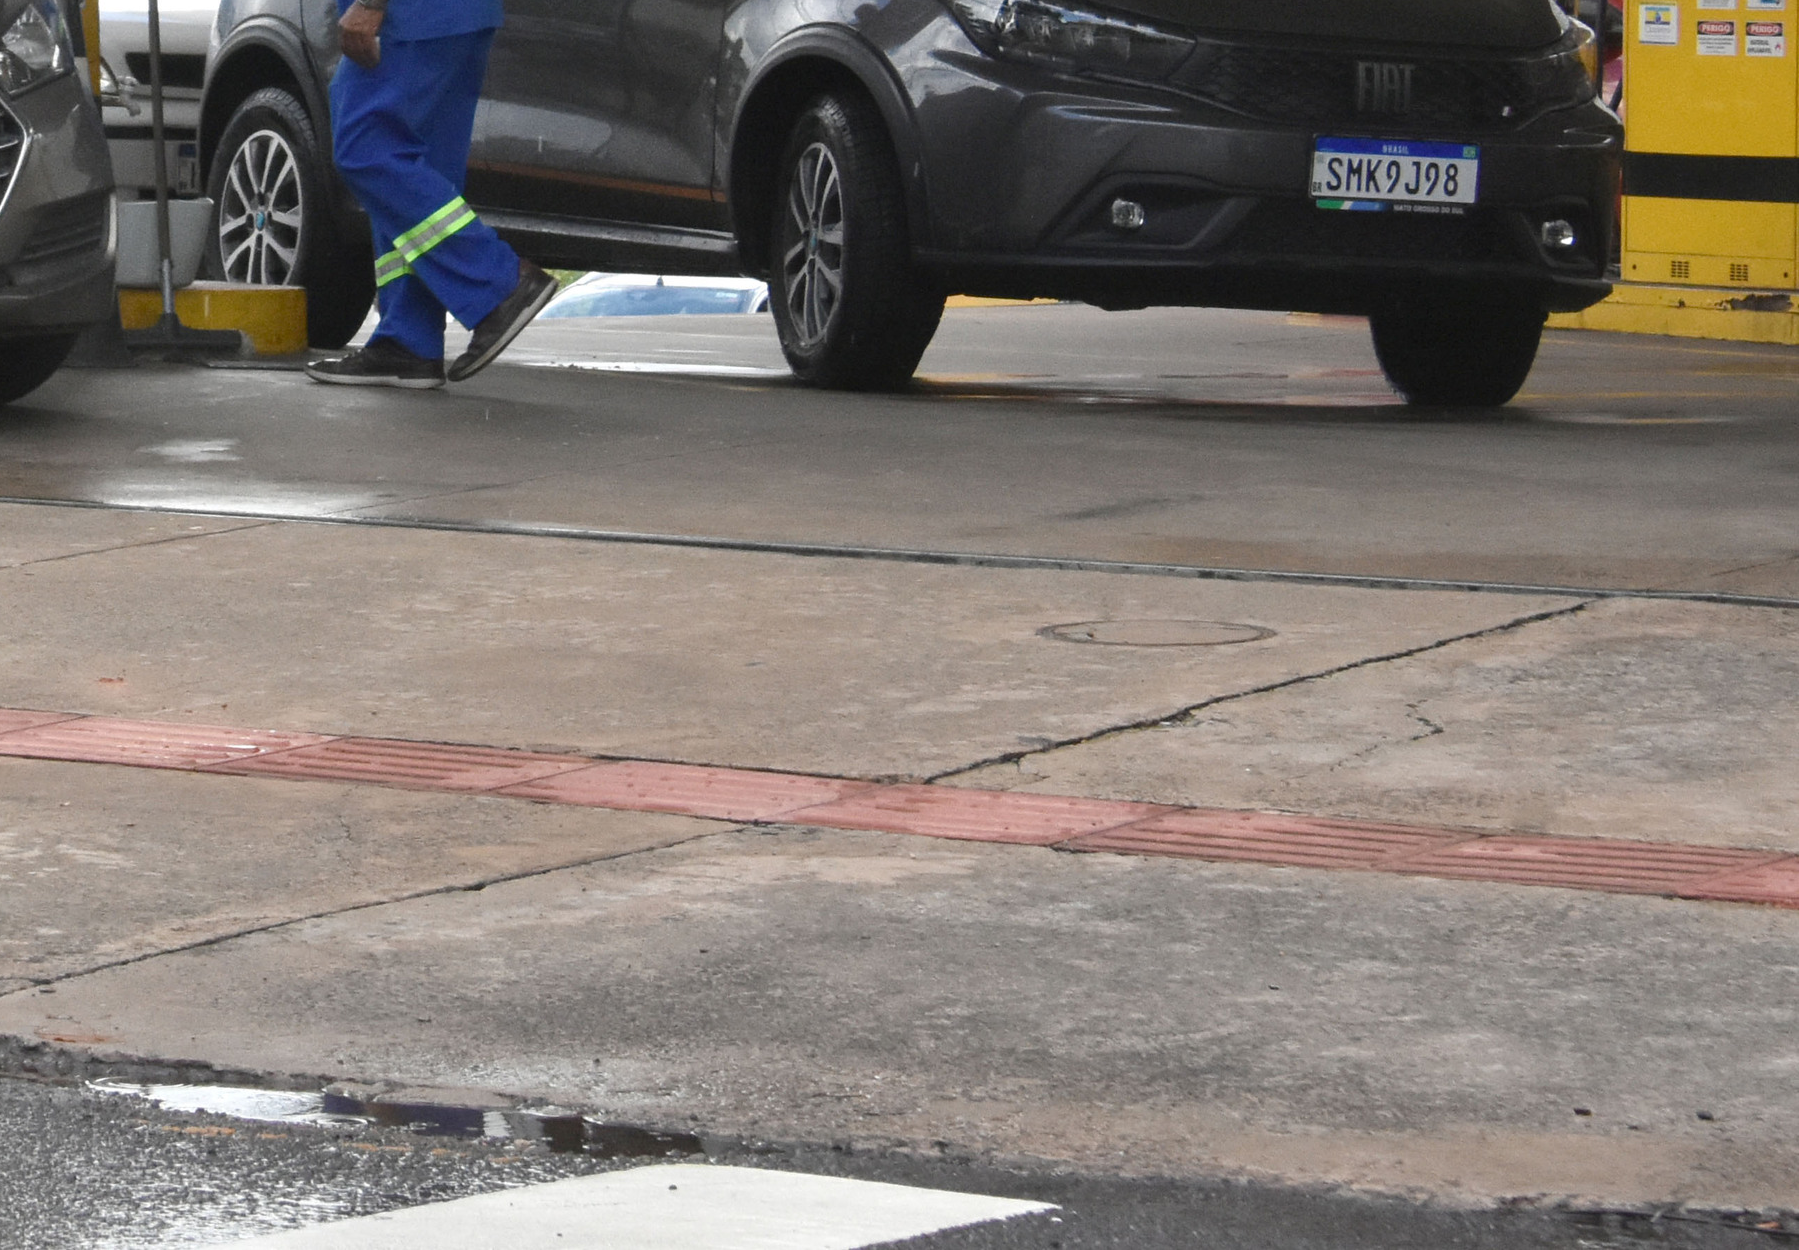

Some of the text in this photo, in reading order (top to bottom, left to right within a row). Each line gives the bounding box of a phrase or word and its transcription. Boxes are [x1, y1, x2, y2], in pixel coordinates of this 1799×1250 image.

[1702, 24, 1731, 32] PERIGO
[1751, 25, 1779, 33] PERIGO
[1357, 61, 1415, 111] FIAT
[1382, 145, 1409, 155] BRASIL
[1326, 157, 1459, 197] SMK9J98
